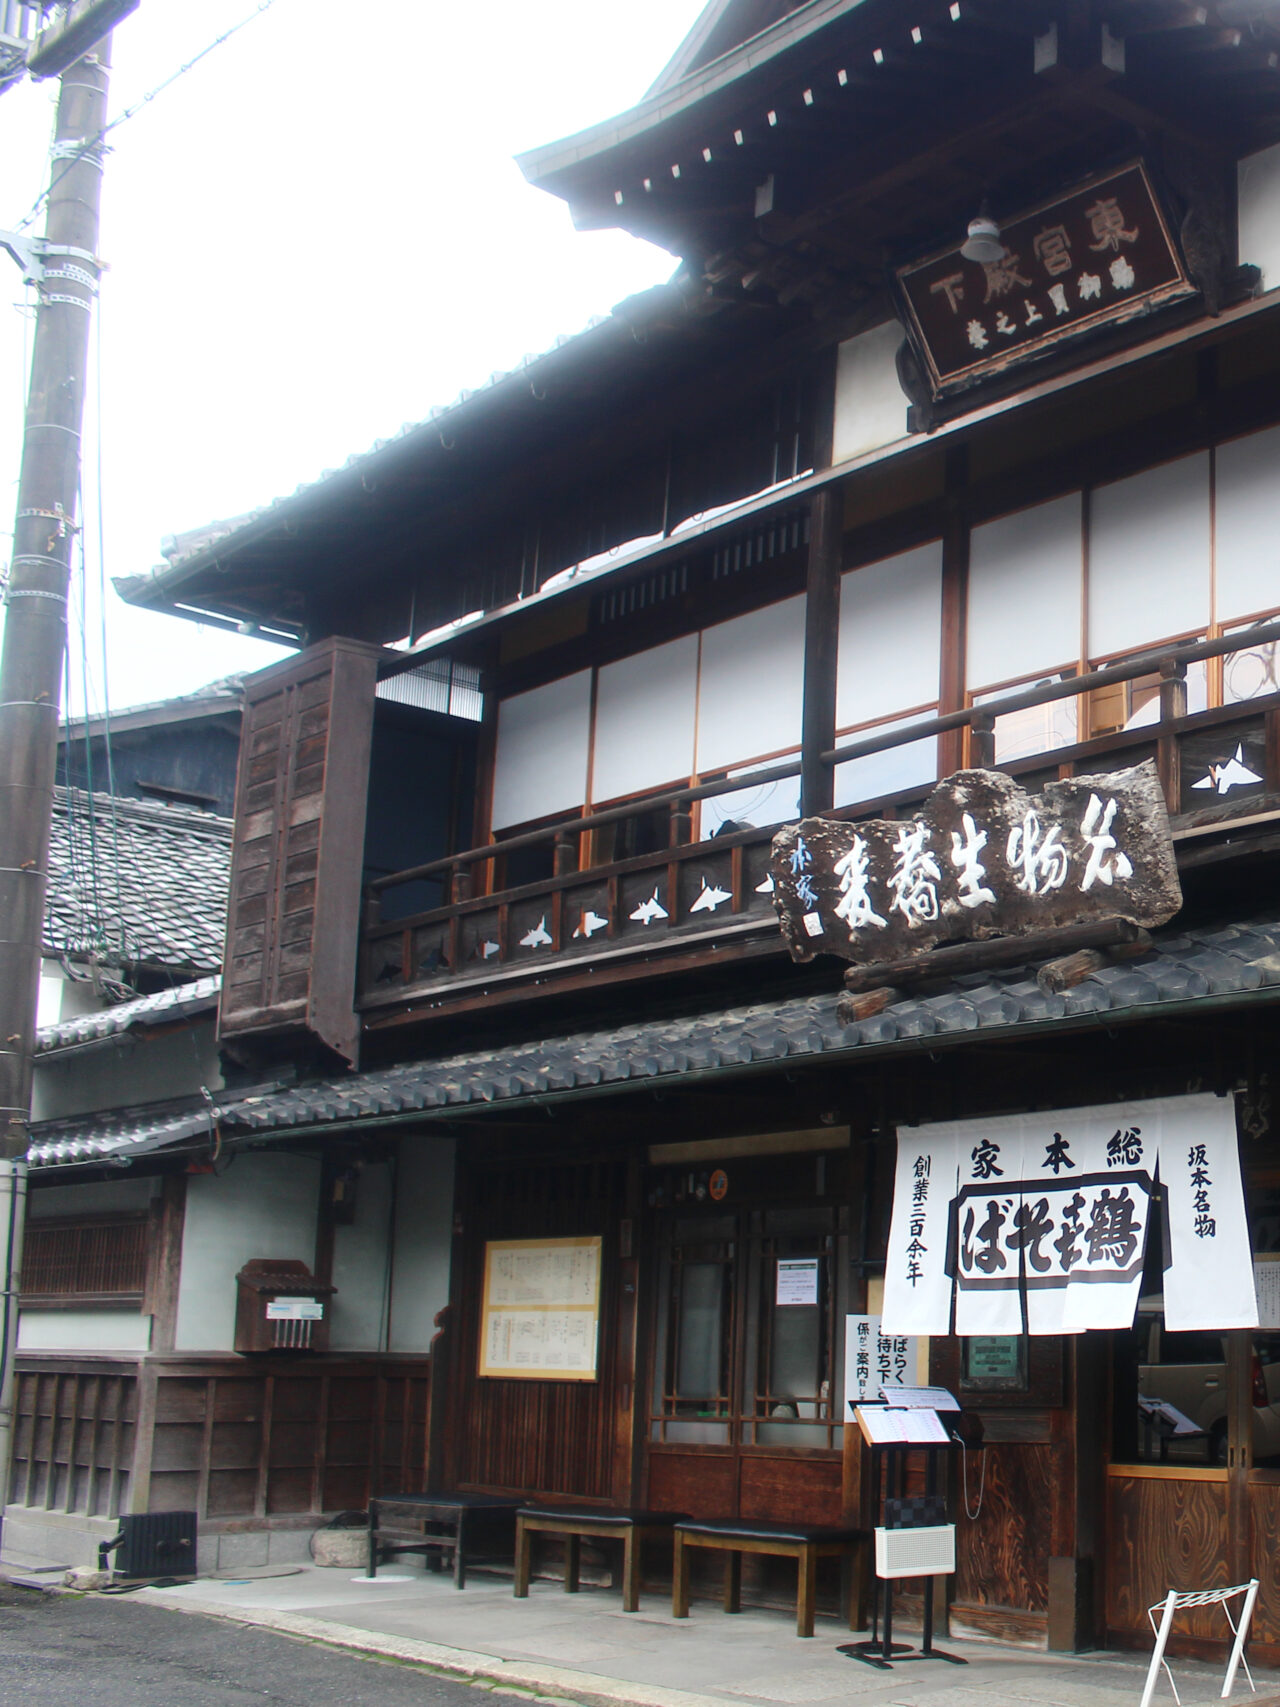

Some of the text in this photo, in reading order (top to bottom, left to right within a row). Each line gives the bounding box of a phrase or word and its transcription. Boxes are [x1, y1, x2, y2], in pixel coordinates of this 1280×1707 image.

[971, 1128, 1143, 1179] 総本家
[905, 1155, 931, 1288] 創業三百余年
[1187, 1144, 1216, 1239] 坂本名物
[893, 1335, 908, 1384] ばらく
